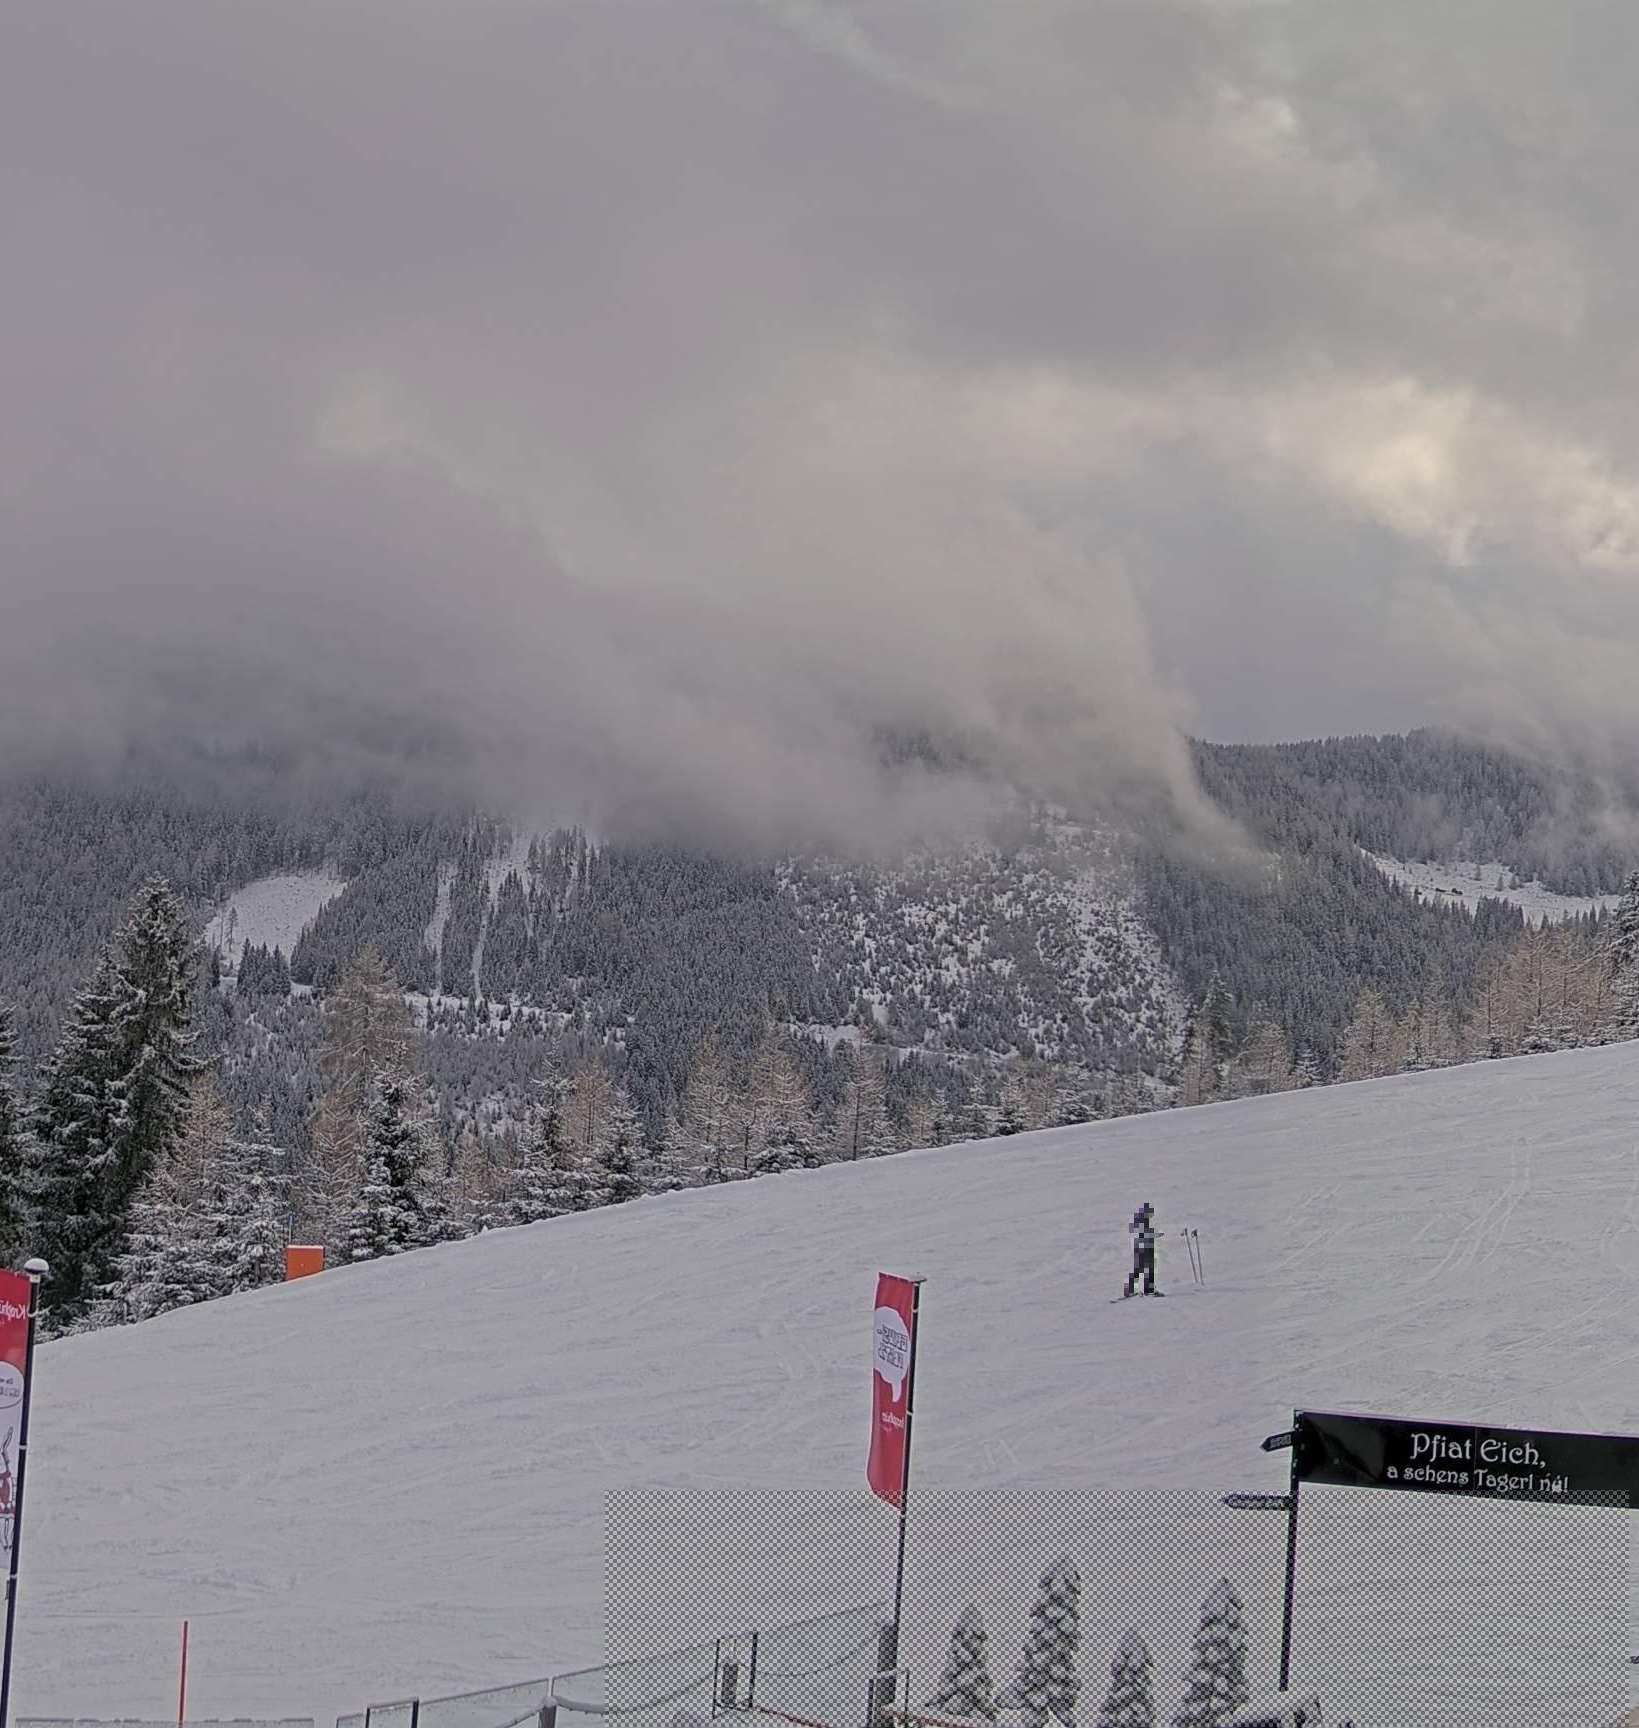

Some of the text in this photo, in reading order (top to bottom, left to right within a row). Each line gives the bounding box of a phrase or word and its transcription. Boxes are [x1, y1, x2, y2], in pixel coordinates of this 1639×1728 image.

[1409, 1432, 1546, 1469] Pfiat Eich,
[1387, 1465, 1398, 1479] a
[1403, 1464, 1470, 1485] schens
[1473, 1468, 1534, 1492] Tagerl
